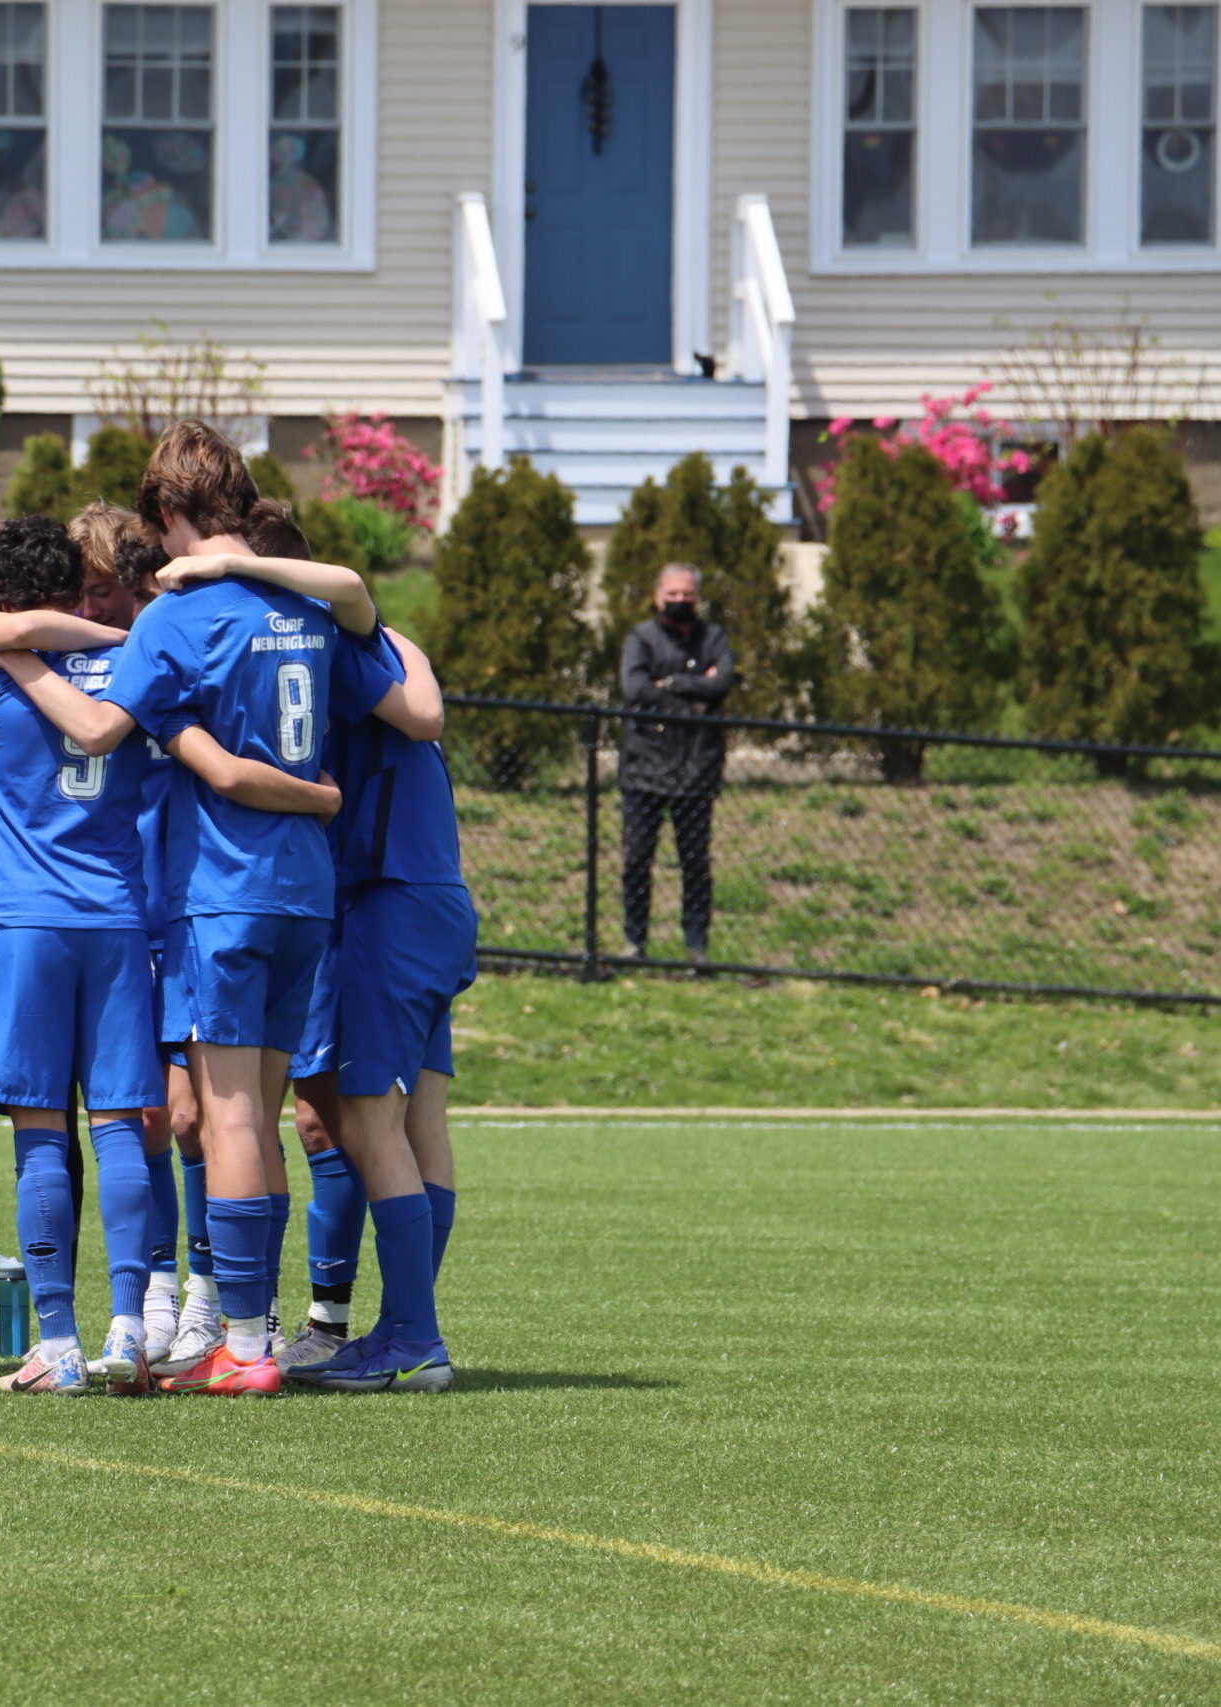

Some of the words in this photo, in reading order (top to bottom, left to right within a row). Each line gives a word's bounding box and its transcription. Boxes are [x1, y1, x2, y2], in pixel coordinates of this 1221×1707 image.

[273, 617, 304, 632] SURF
[276, 634, 325, 650] ENGLAND
[73, 658, 110, 673] SURF
[278, 661, 315, 765] 8
